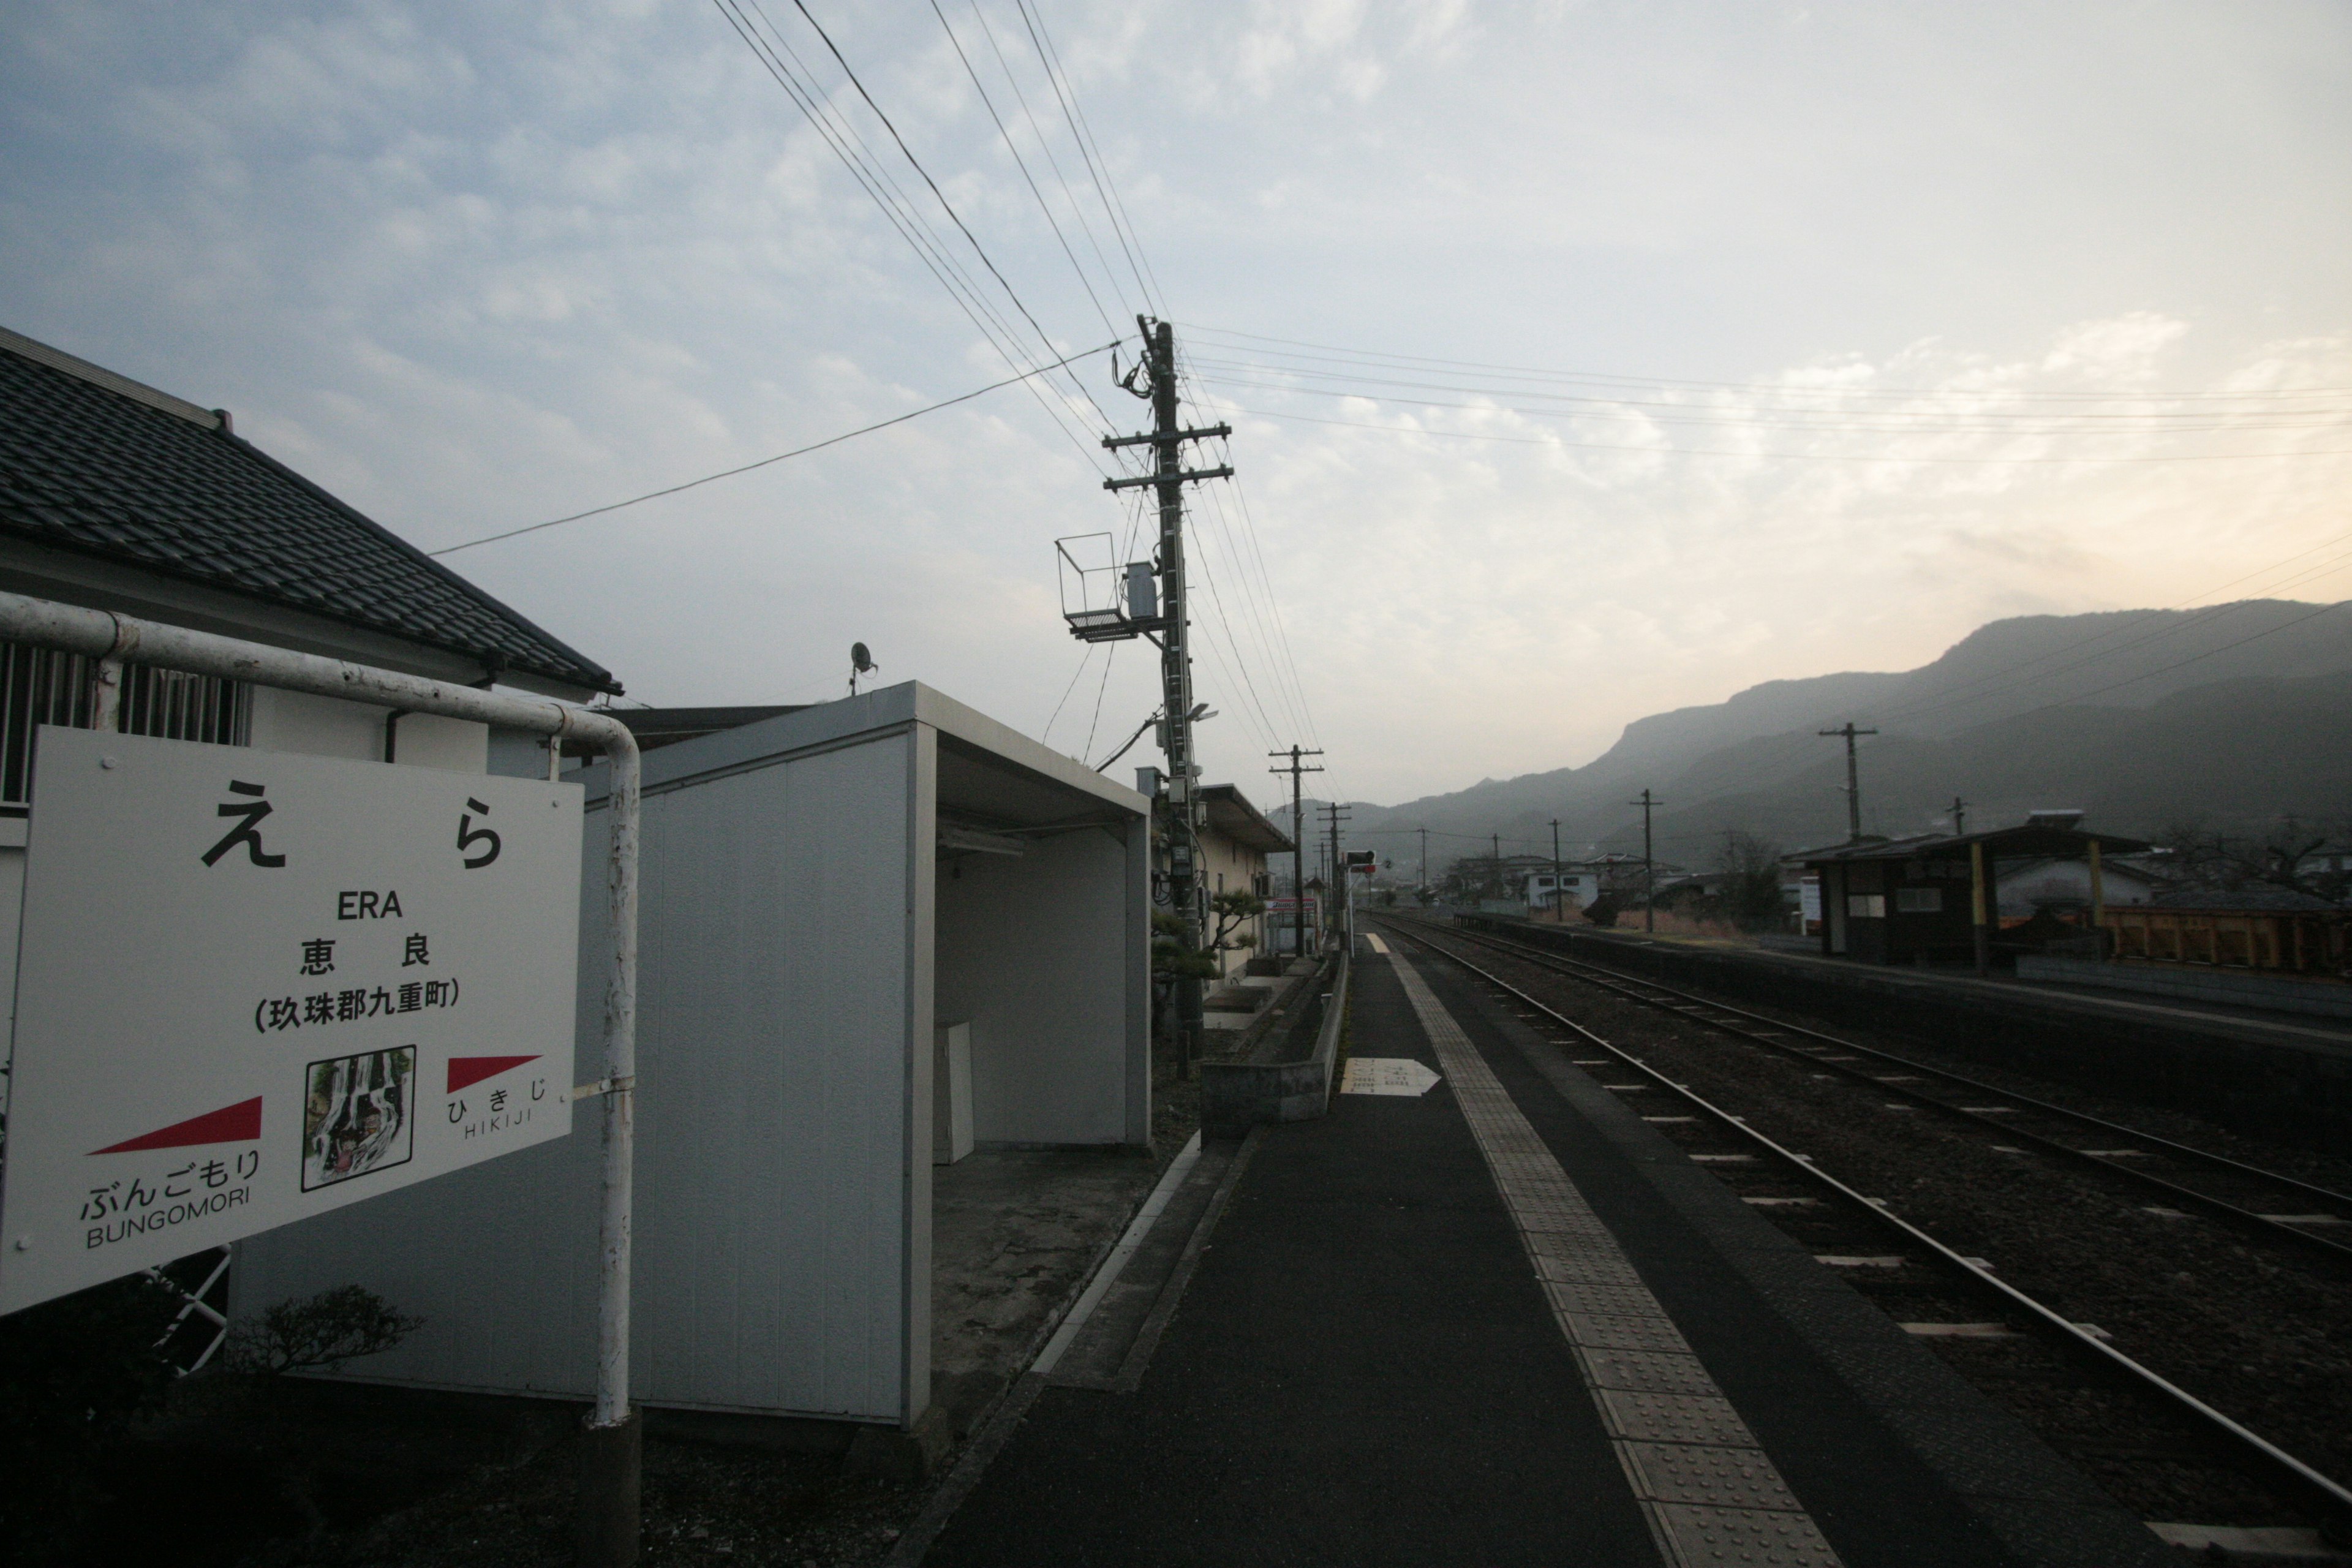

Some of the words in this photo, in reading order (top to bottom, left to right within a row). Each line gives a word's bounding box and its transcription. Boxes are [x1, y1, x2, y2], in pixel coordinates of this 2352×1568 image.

[337, 890, 403, 921] ERA
[299, 932, 430, 976] 恵良
[255, 977, 459, 1035] (玖珠郡九重町)
[448, 1078, 545, 1124] ひきじ
[465, 1109, 532, 1139] HIKIJI
[80, 1150, 259, 1221] ぶんごもり
[86, 1186, 250, 1250] BUNGOMORI
